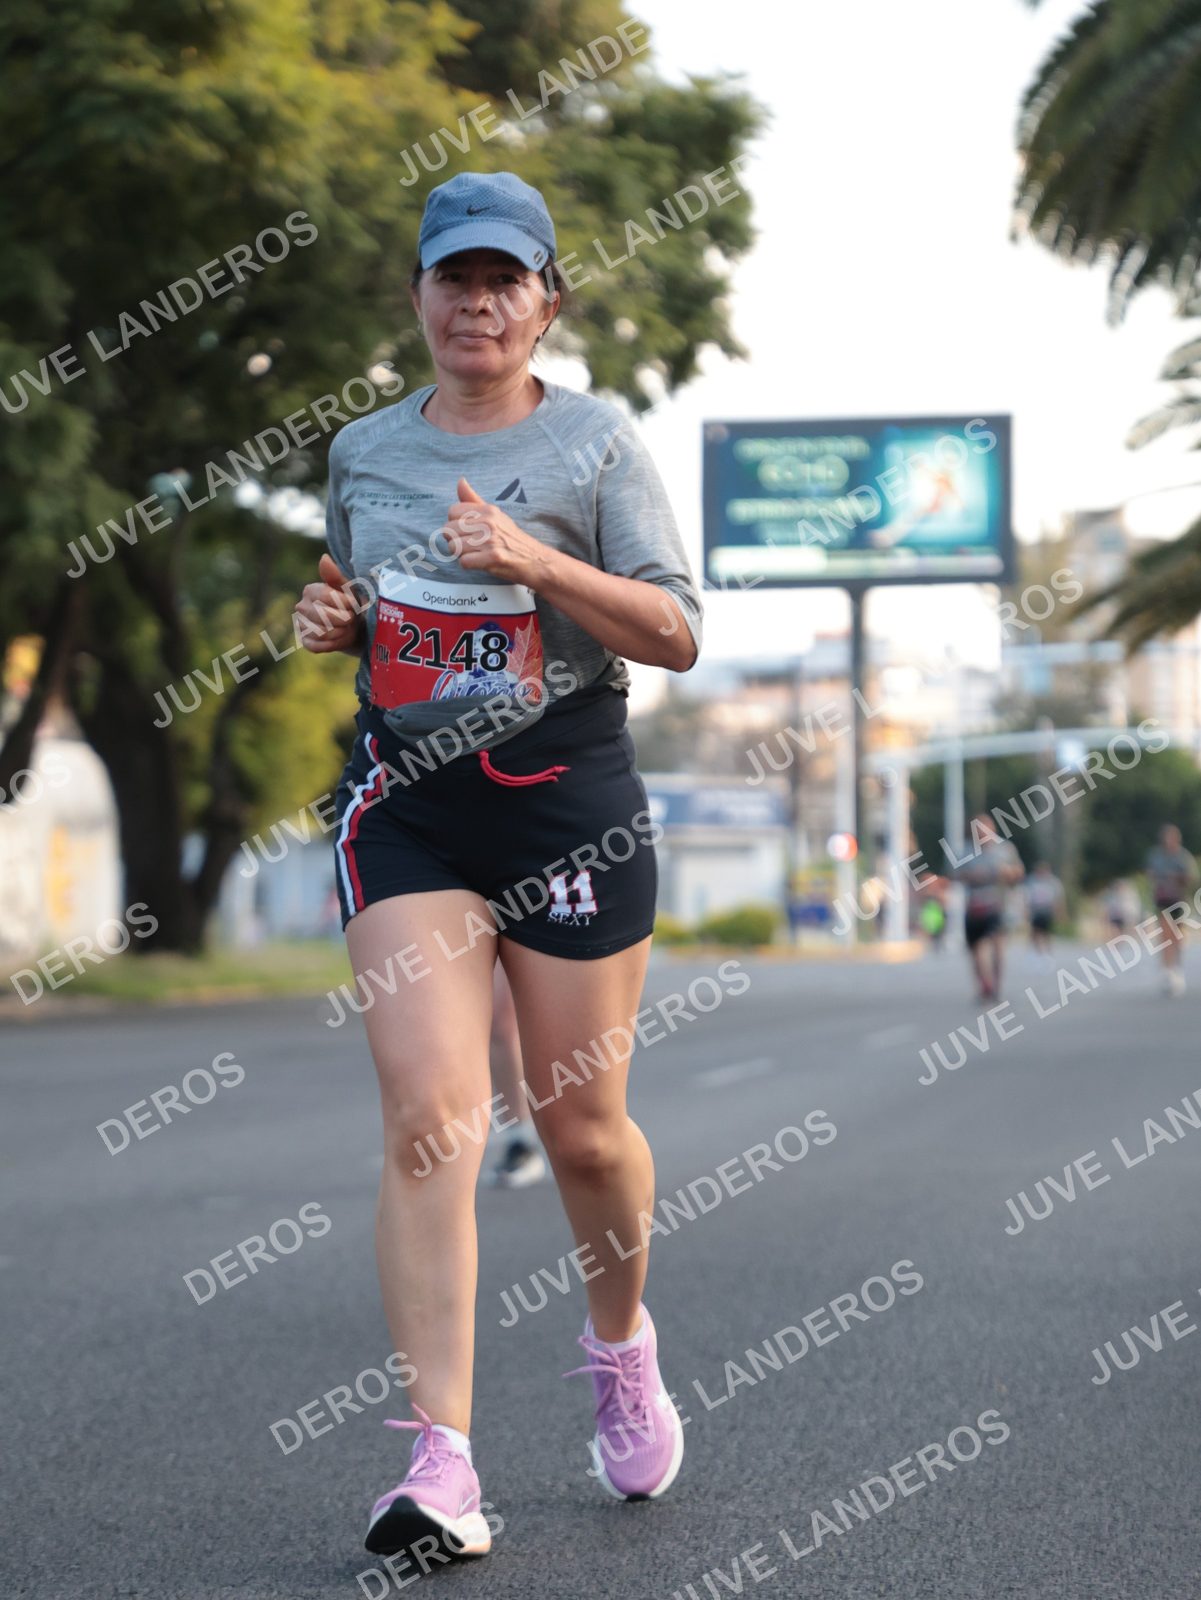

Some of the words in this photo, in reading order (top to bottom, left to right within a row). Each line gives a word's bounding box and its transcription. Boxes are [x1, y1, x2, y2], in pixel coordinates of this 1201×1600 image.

[422, 592, 476, 606] Openbank
[398, 622, 508, 672] 2148
[548, 870, 598, 914] 11
[547, 912, 598, 926] SEXY
